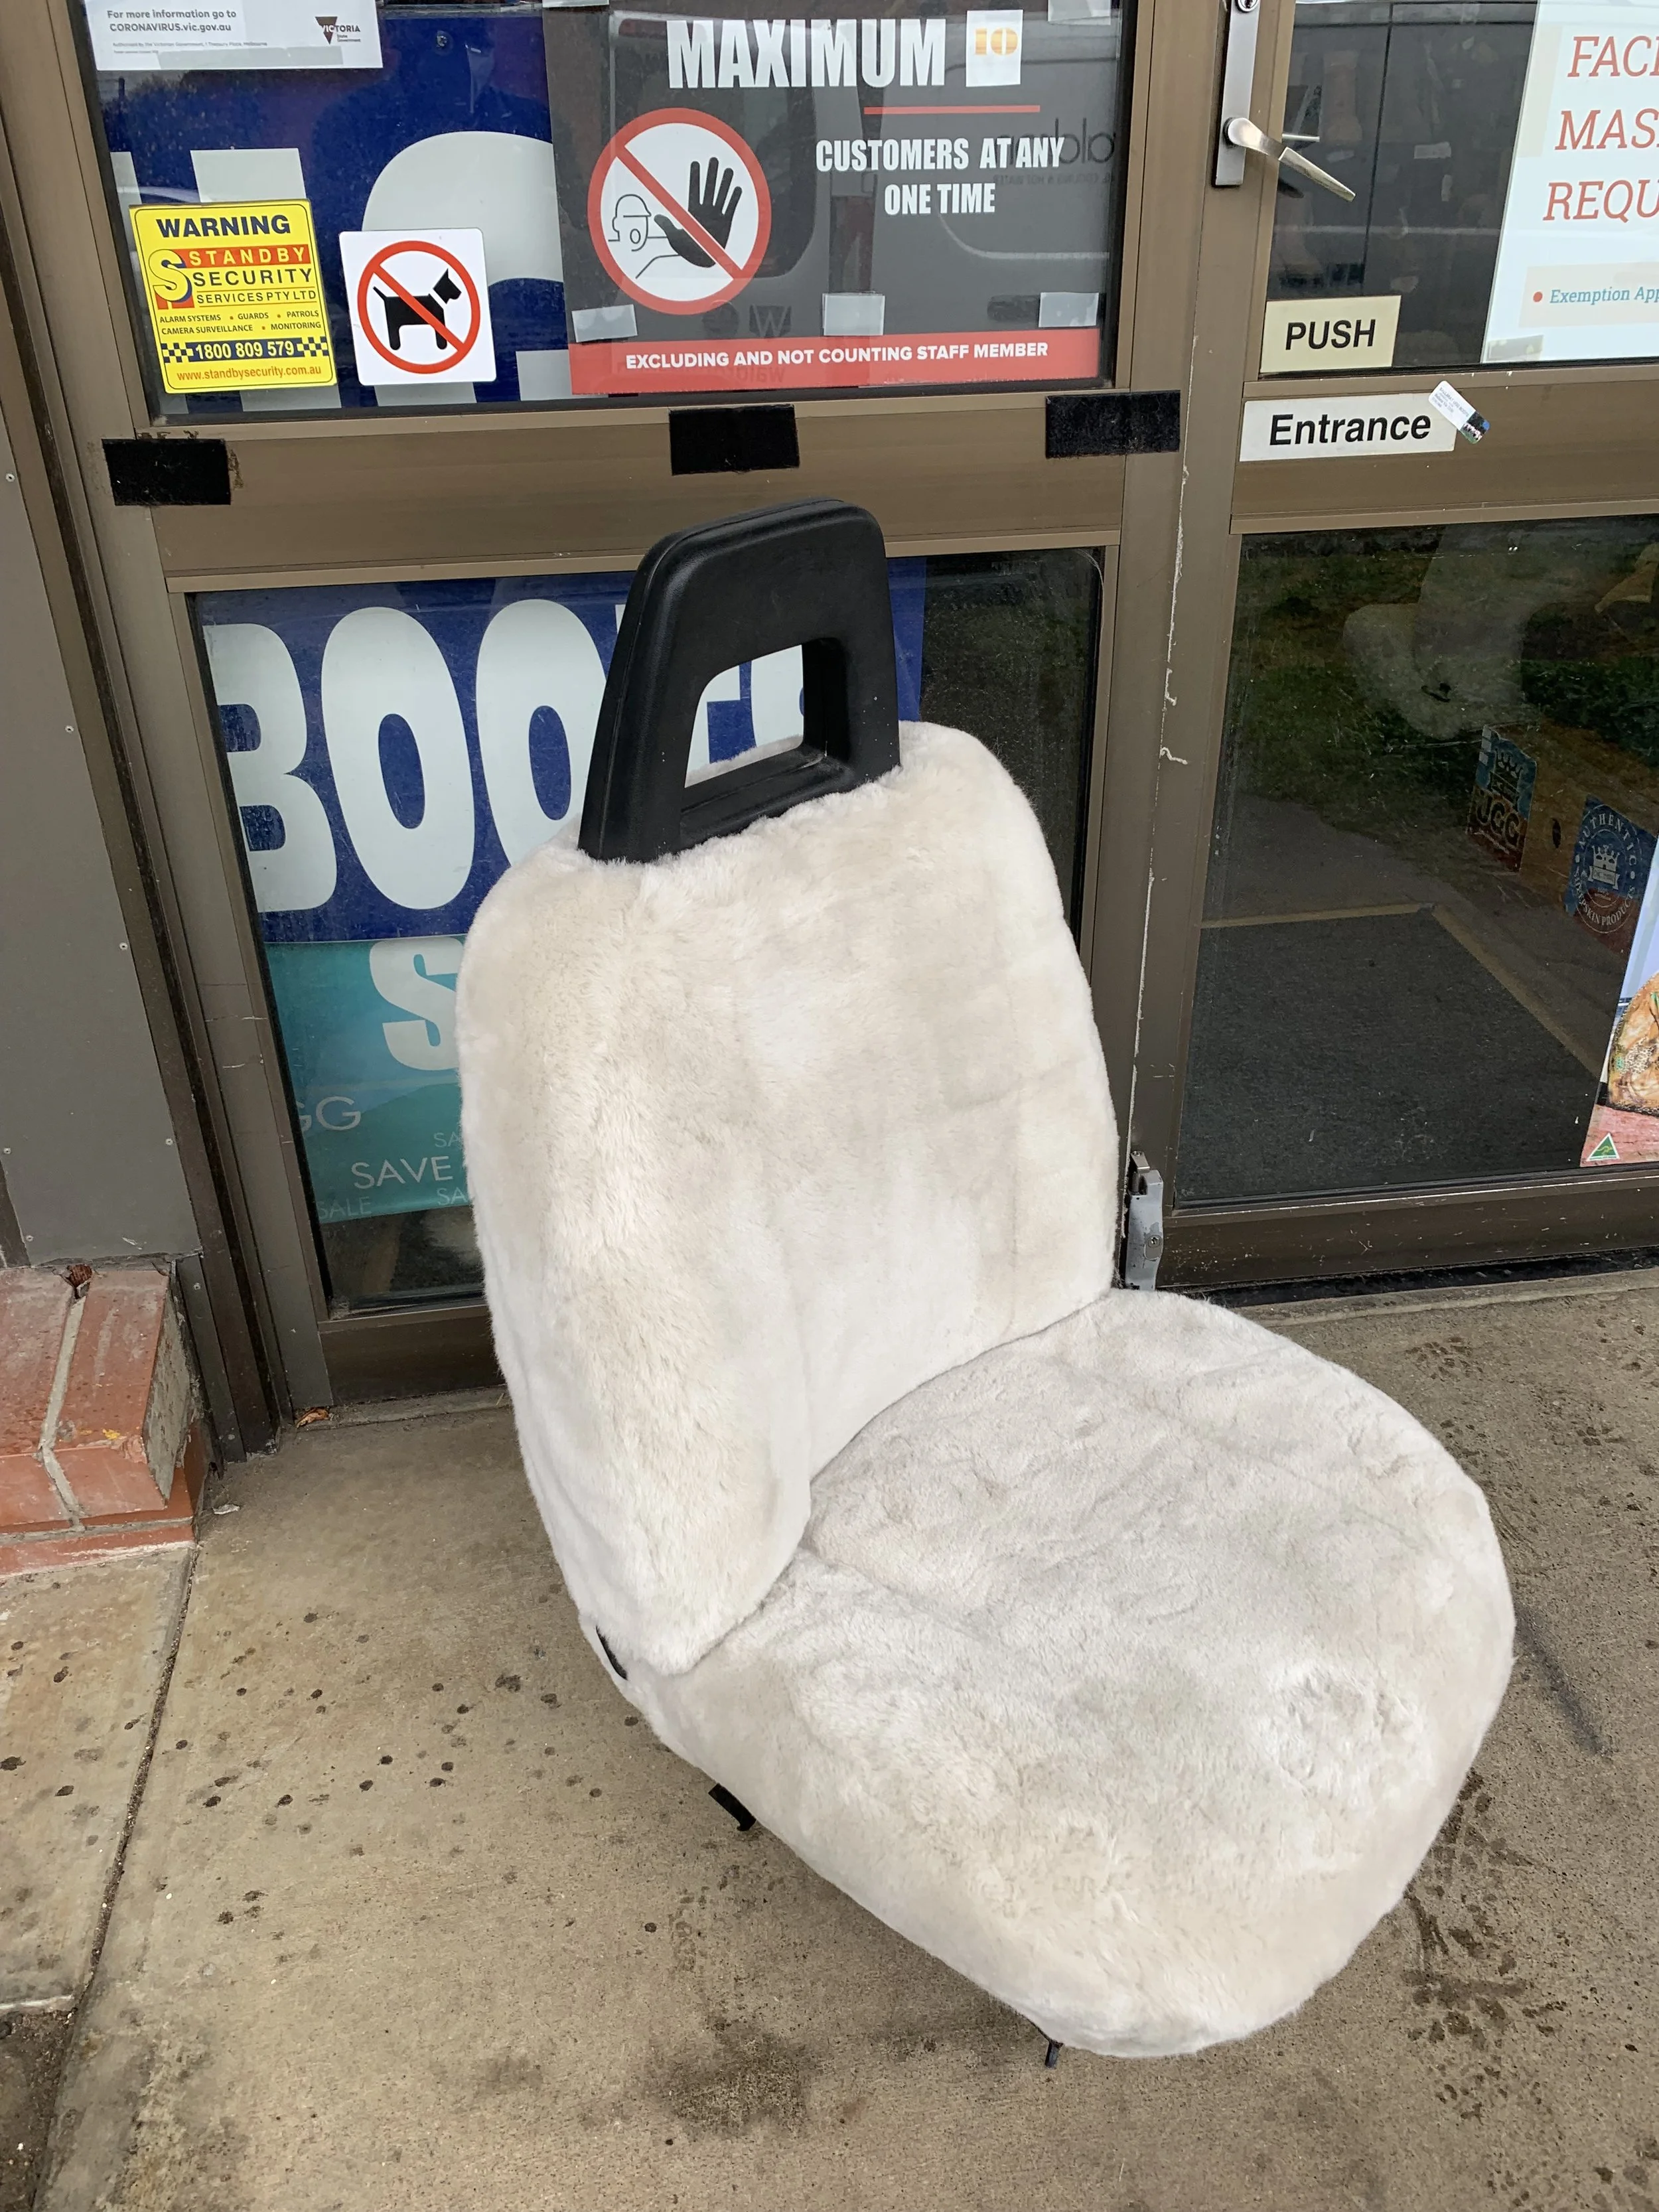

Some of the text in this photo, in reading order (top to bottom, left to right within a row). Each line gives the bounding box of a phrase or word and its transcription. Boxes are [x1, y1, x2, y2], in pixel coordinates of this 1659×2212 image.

[107, 10, 123, 19] For
[153, 9, 210, 18] information
[212, 11, 224, 20] go
[226, 9, 236, 18] to
[109, 23, 232, 33] CORONAVIRUS.vic.gov.au
[666, 19, 1018, 88] MAXIMUM 10
[1555, 108, 1659, 150] MAS
[816, 137, 1064, 172] CUSTOMERS AT ANY
[884, 183, 995, 216] ONE TIME
[1542, 179, 1659, 223] REQU
[156, 214, 291, 238] WARNING
[188, 246, 306, 266] STANDBY
[192, 267, 312, 287] SECURITY
[196, 290, 317, 304] SERVICES PTY LTD
[1550, 286, 1659, 305] Exemption App
[159, 315, 186, 323] ALARM
[161, 322, 321, 335] CAMERA SURVEILLANCE MONITORING
[1285, 319, 1376, 350] PUSH
[195, 340, 294, 360] 1800 809 579
[626, 342, 1048, 369] EXCLUDING AND NOT COUNTING STAFF MEMBER
[177, 365, 321, 381] www.standbysecurity.com.au
[1269, 412, 1431, 446] Entrance
[1579, 813, 1636, 865] AUTHENTIC
[351, 1155, 453, 1189] SAVE
